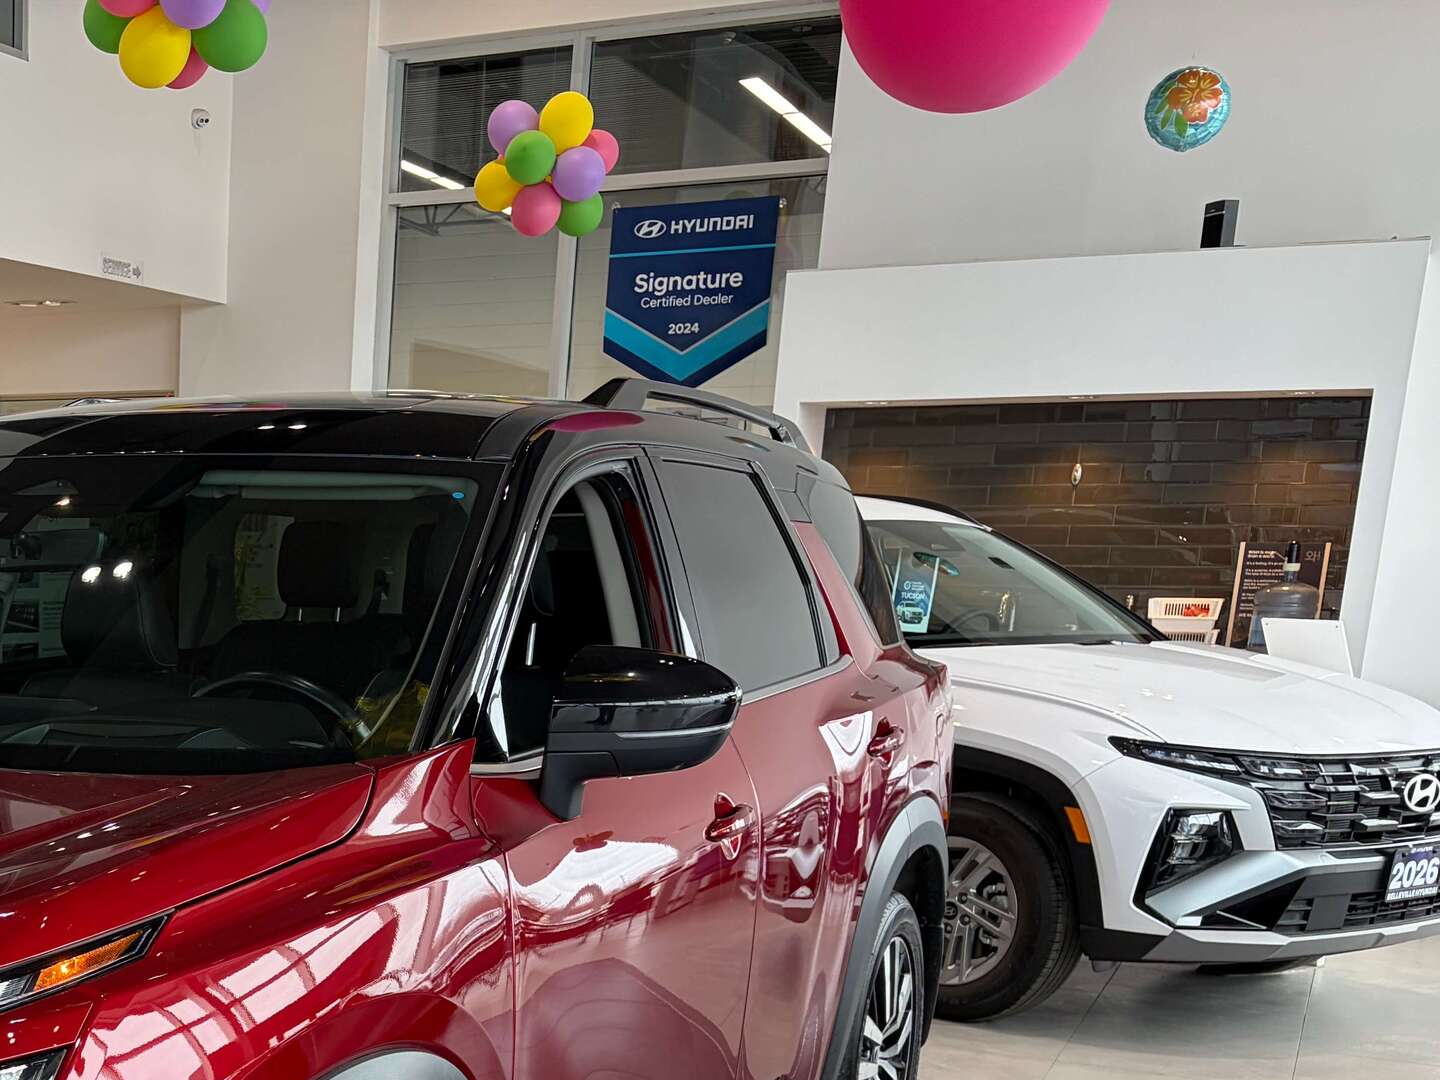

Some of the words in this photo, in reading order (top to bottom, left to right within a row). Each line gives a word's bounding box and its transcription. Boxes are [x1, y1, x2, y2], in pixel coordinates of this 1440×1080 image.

[670, 214, 754, 234] HYUNDAI
[634, 271, 743, 295] Signature
[640, 296, 691, 308] Certified
[694, 293, 734, 306] Dealer
[668, 323, 700, 335] 2024
[1388, 857, 1440, 890] 2026
